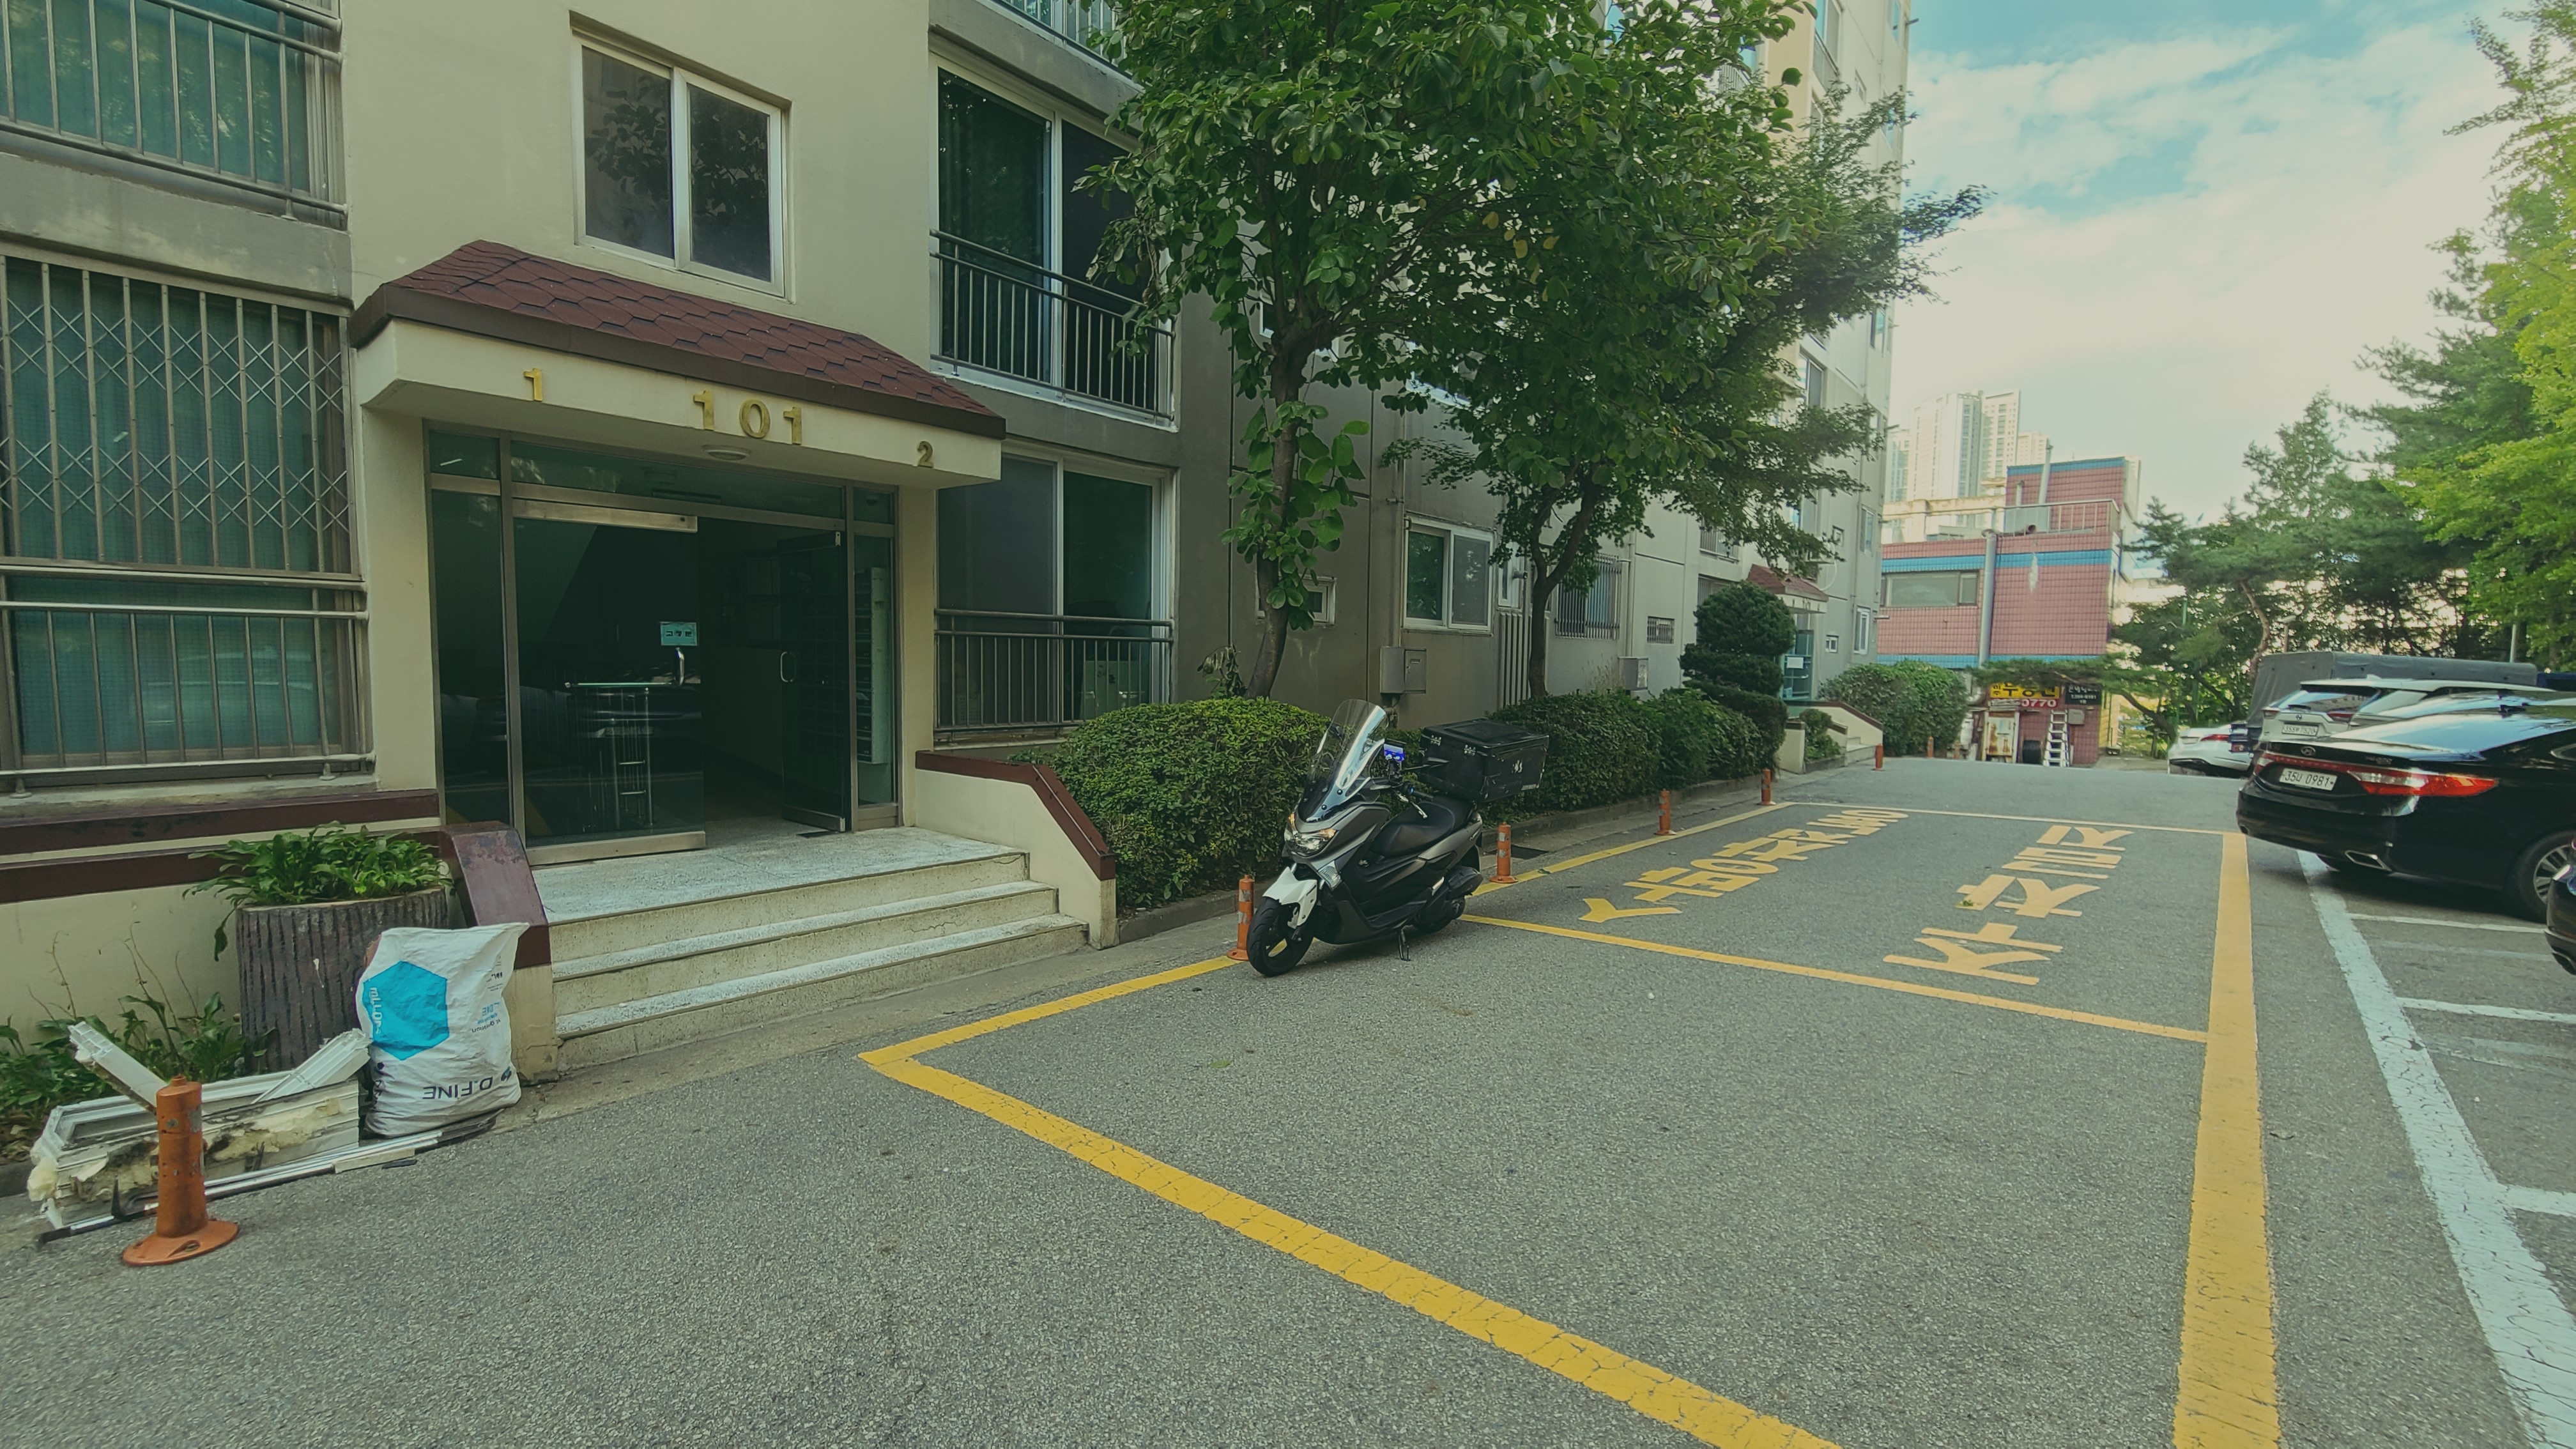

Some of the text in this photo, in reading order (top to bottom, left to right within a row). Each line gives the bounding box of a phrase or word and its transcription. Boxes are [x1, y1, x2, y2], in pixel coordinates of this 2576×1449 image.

[524, 368, 933, 468] 1 101 2
[2305, 774, 2331, 787] 0981
[1883, 825, 2135, 985] 주차금지
[422, 1077, 493, 1100] D.FINE
